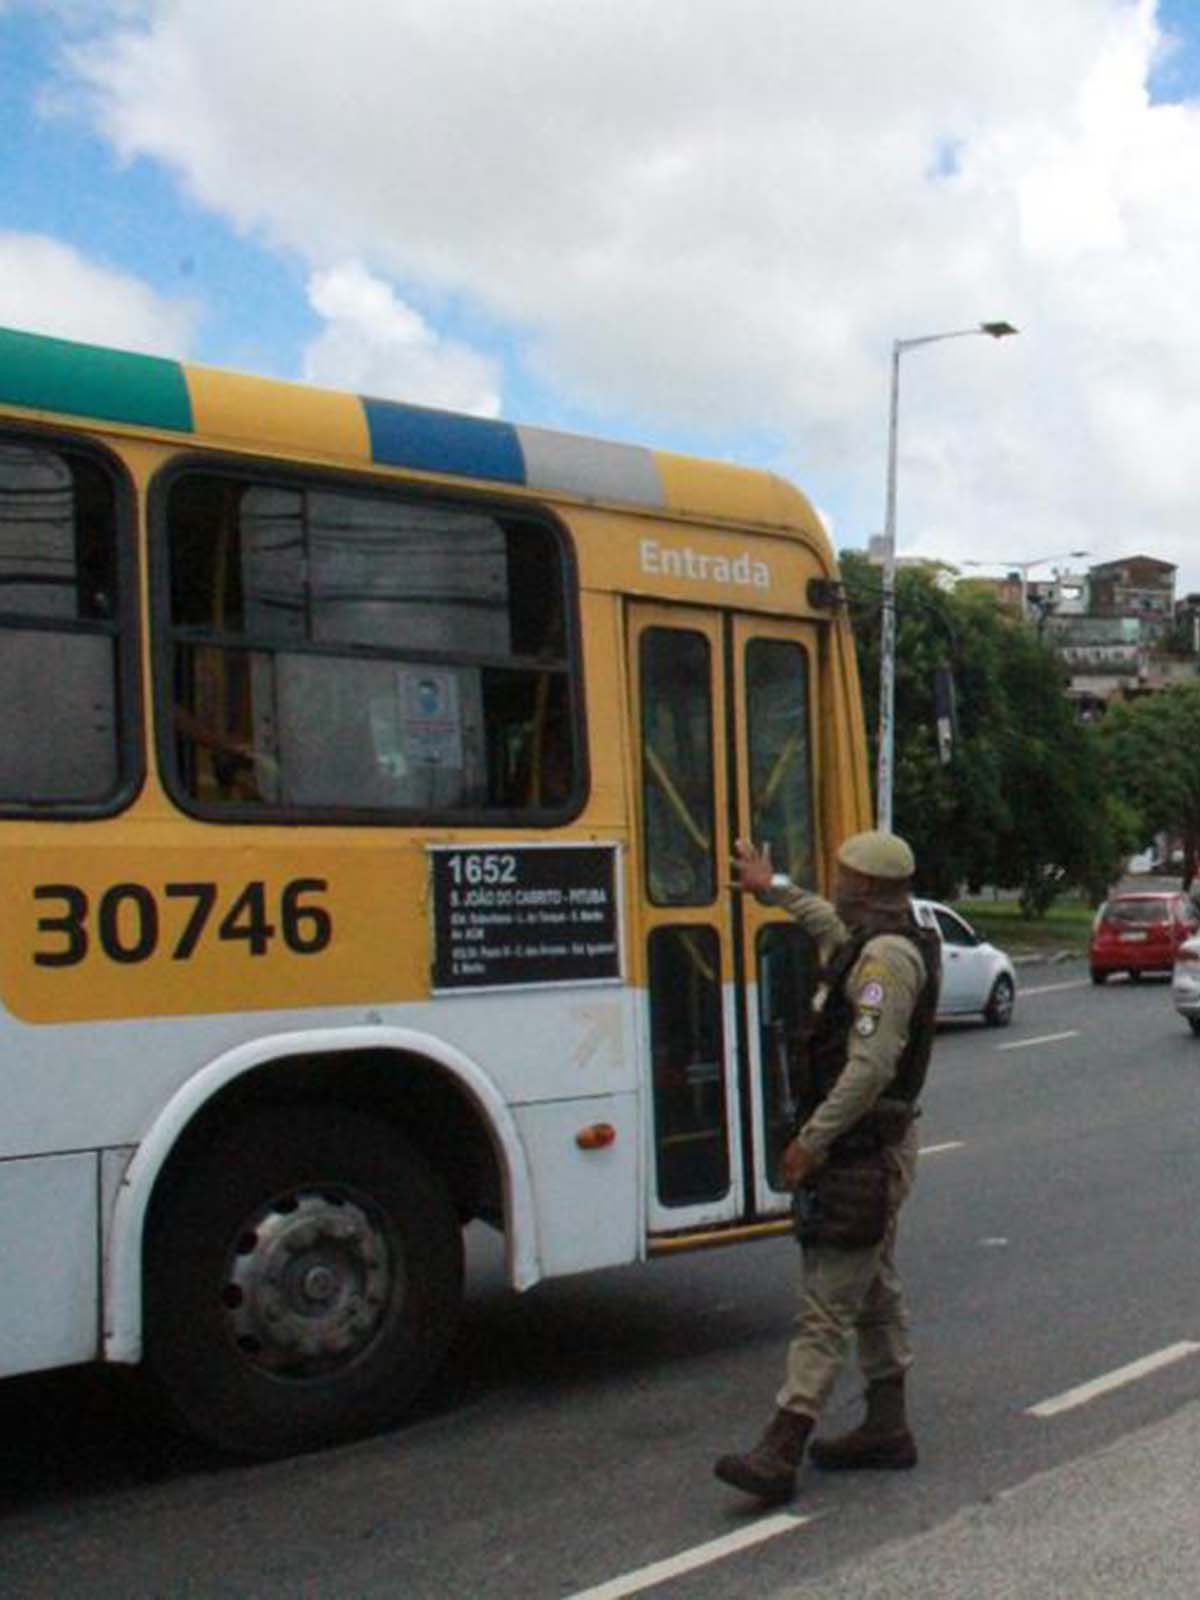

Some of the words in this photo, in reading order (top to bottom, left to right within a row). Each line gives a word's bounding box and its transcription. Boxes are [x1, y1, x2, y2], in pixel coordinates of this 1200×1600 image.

[639, 539, 769, 587] Entrada
[448, 855, 517, 883] 1652
[33, 877, 332, 967] 30746
